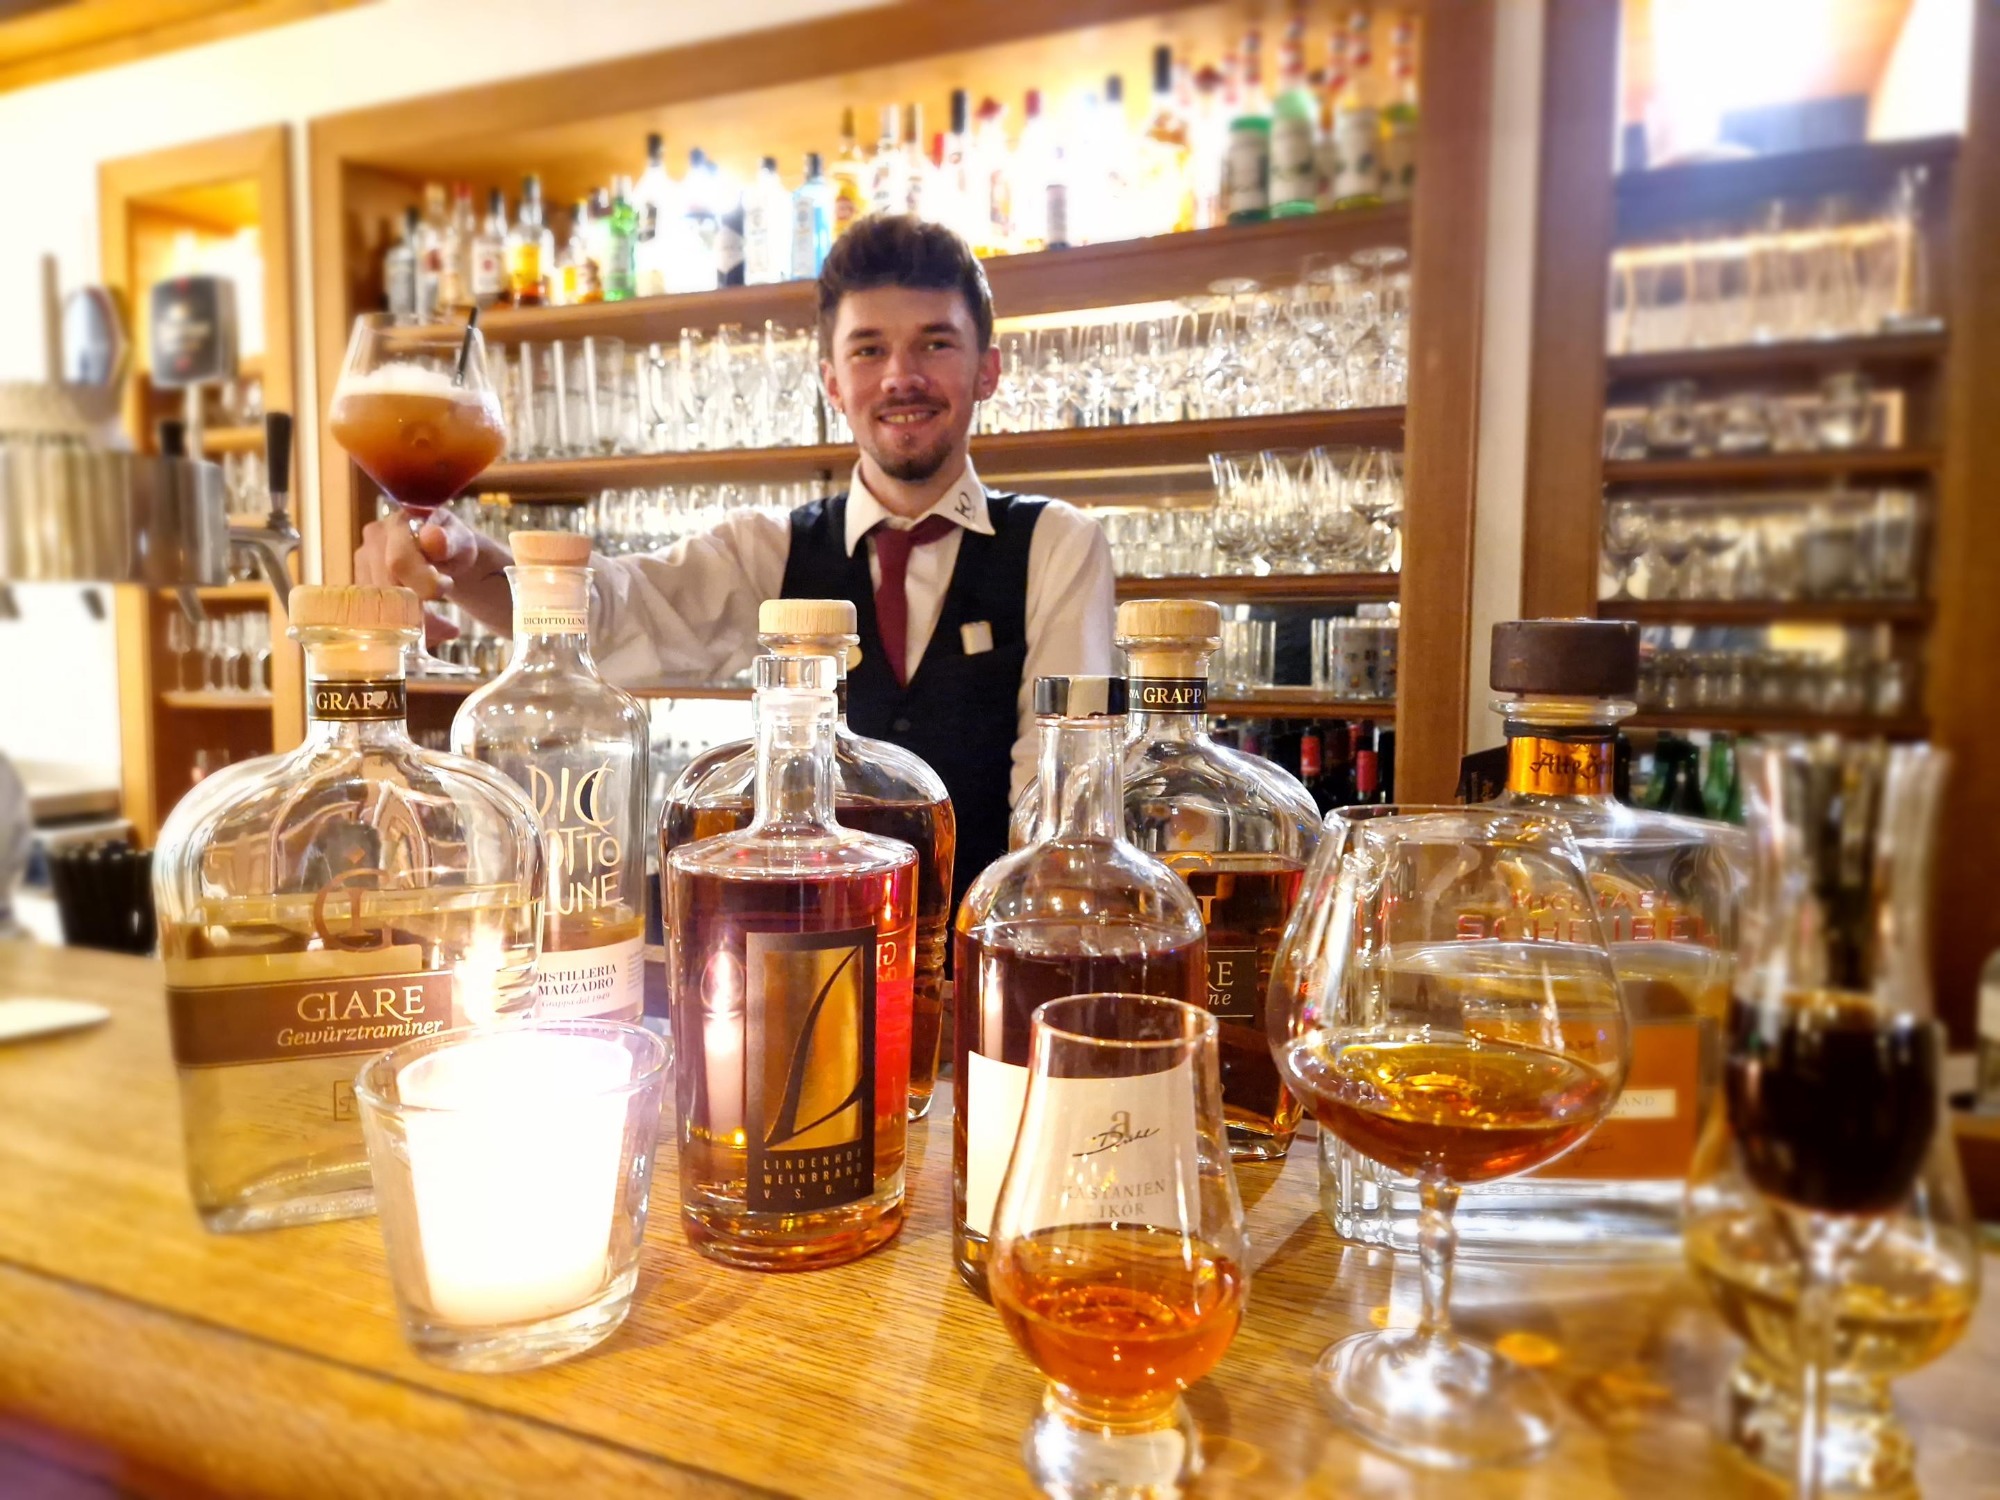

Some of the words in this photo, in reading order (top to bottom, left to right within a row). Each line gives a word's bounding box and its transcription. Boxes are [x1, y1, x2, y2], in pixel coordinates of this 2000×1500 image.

[523, 617, 566, 625] DICIOTTO
[316, 692, 399, 710] GRAPA
[1143, 687, 1207, 704] GRAPPA
[544, 826, 621, 876] OTTO
[538, 963, 618, 984] DISTILLERIA
[538, 977, 615, 997] MARZADRO
[297, 985, 426, 1022] GIARE
[277, 1020, 444, 1047] Gewürztraminer
[763, 1162, 862, 1186] WEINBRAND
